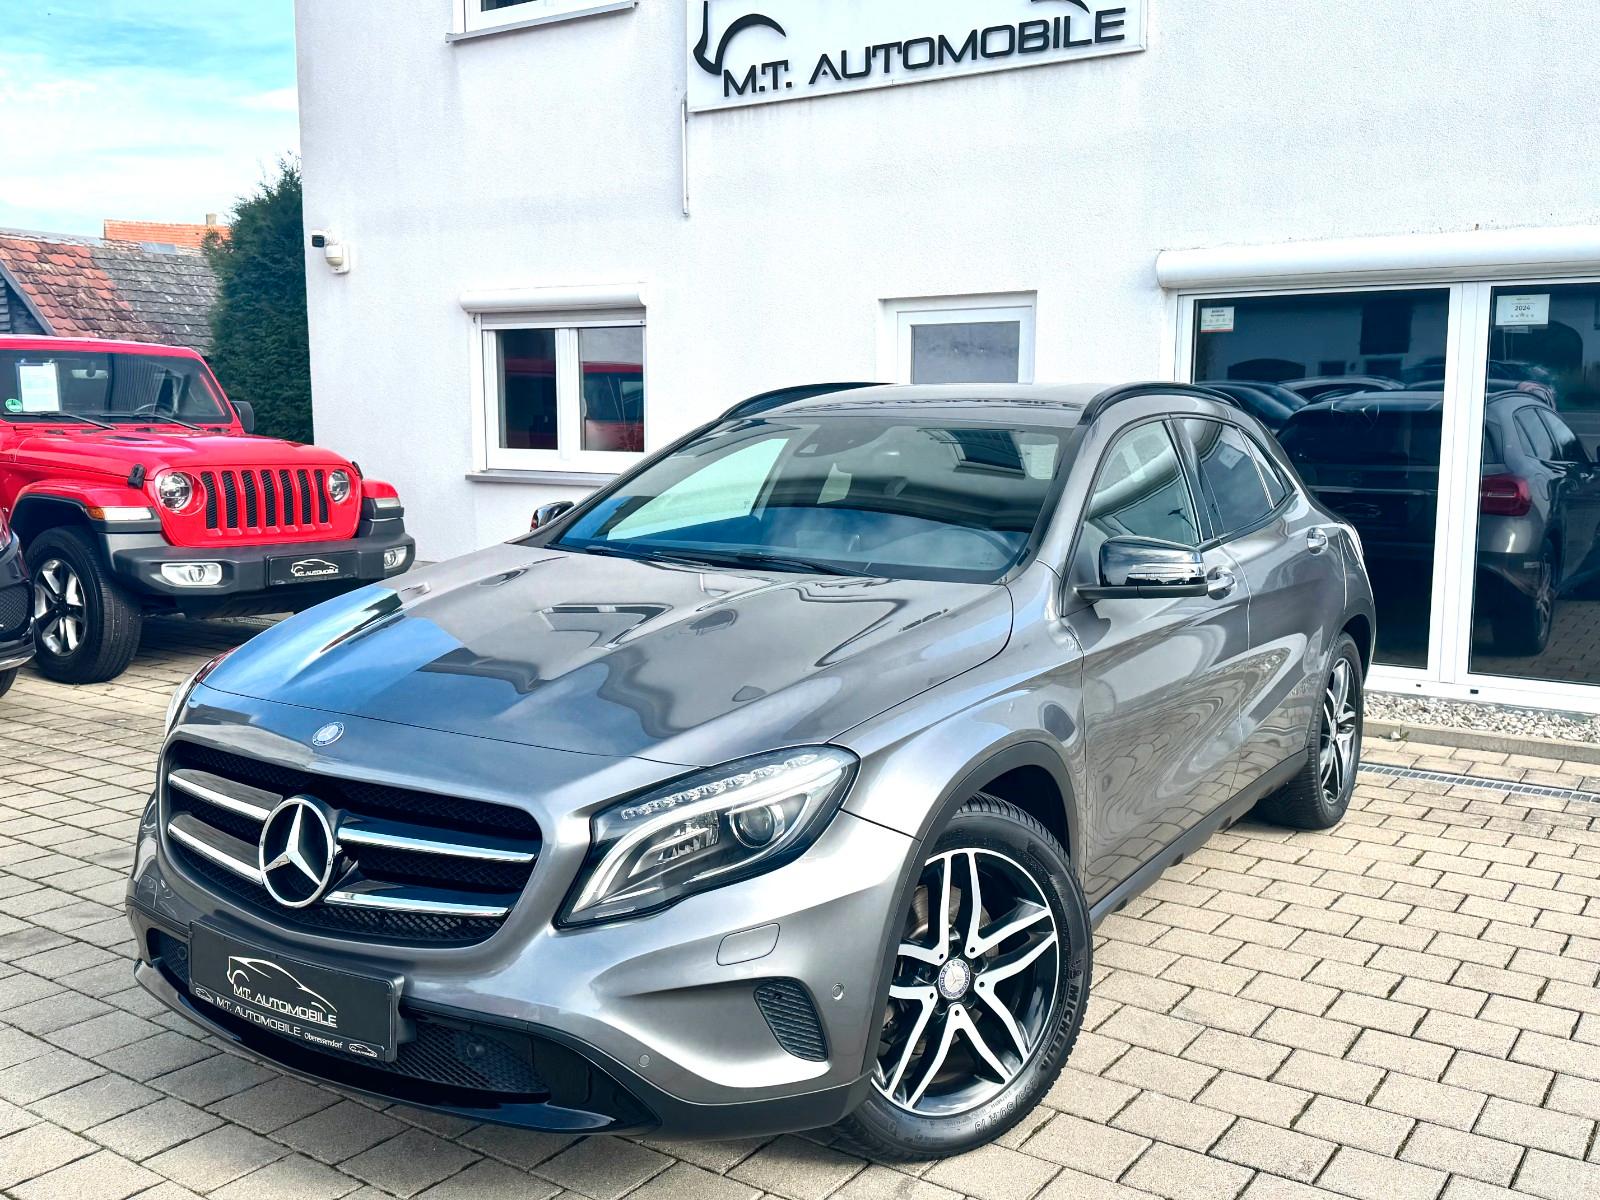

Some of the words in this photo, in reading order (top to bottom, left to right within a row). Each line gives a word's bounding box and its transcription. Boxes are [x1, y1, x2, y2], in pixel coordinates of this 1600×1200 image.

[724, 59, 792, 97] M.T.
[809, 7, 1126, 85] AUTOMOBILE
[233, 983, 251, 1000] M.T.
[255, 993, 337, 1026] AUTOMOBILE
[234, 1005, 302, 1037] AUTOMOBILE
[1040, 984, 1080, 1070] MICHELIN
